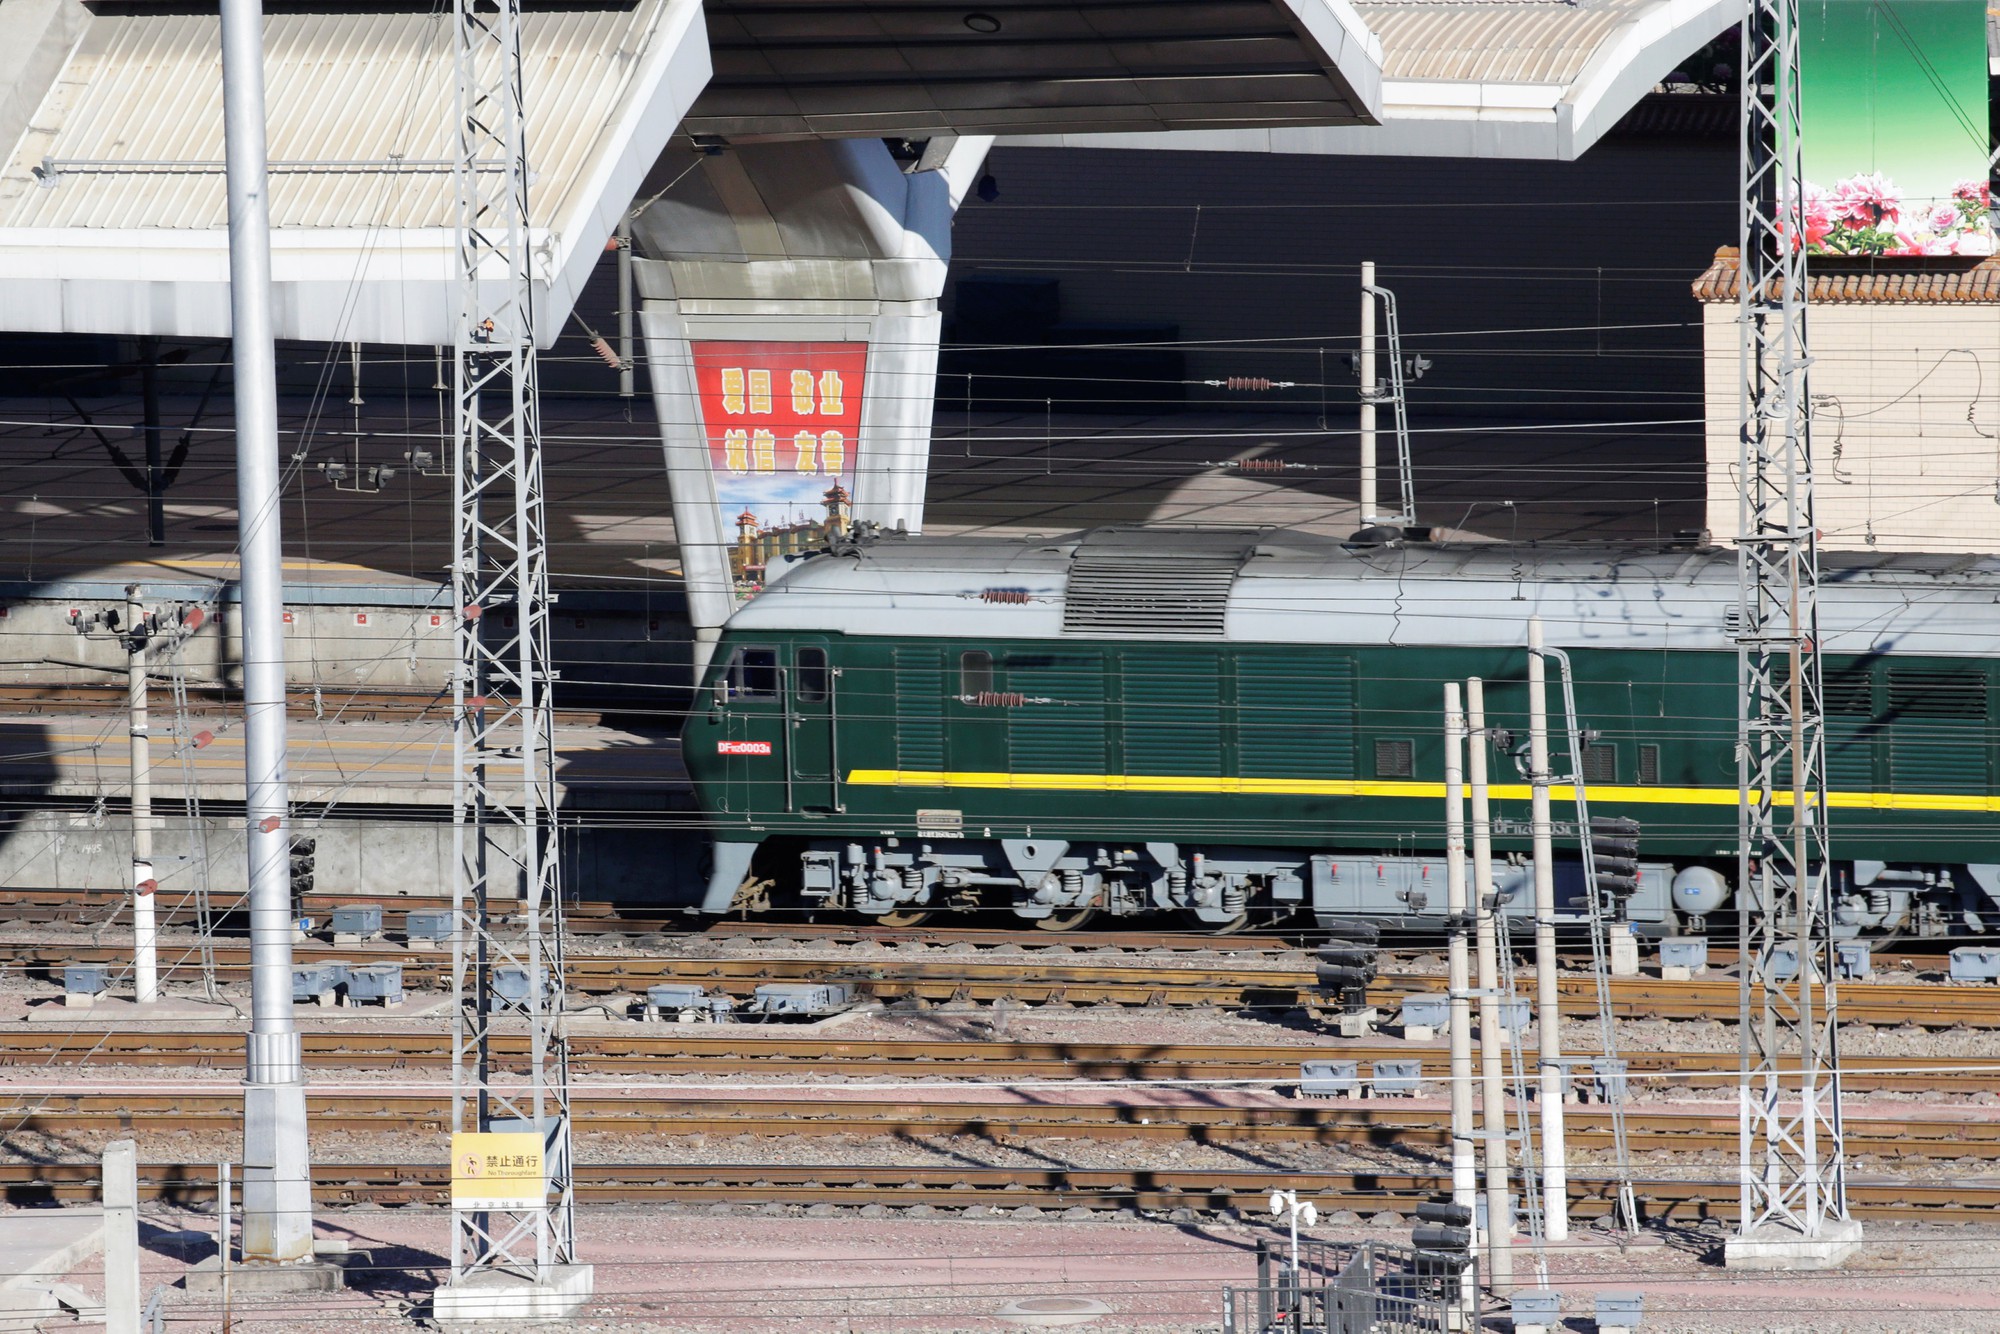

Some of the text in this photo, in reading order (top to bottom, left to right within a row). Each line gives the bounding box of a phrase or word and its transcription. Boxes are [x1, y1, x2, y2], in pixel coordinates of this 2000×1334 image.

[721, 368, 844, 416] 爱国 敬业
[725, 429, 844, 477] 诚信 友善
[486, 1155, 539, 1168] 禁止通行
[498, 1169, 537, 1177] Thoroughfare
